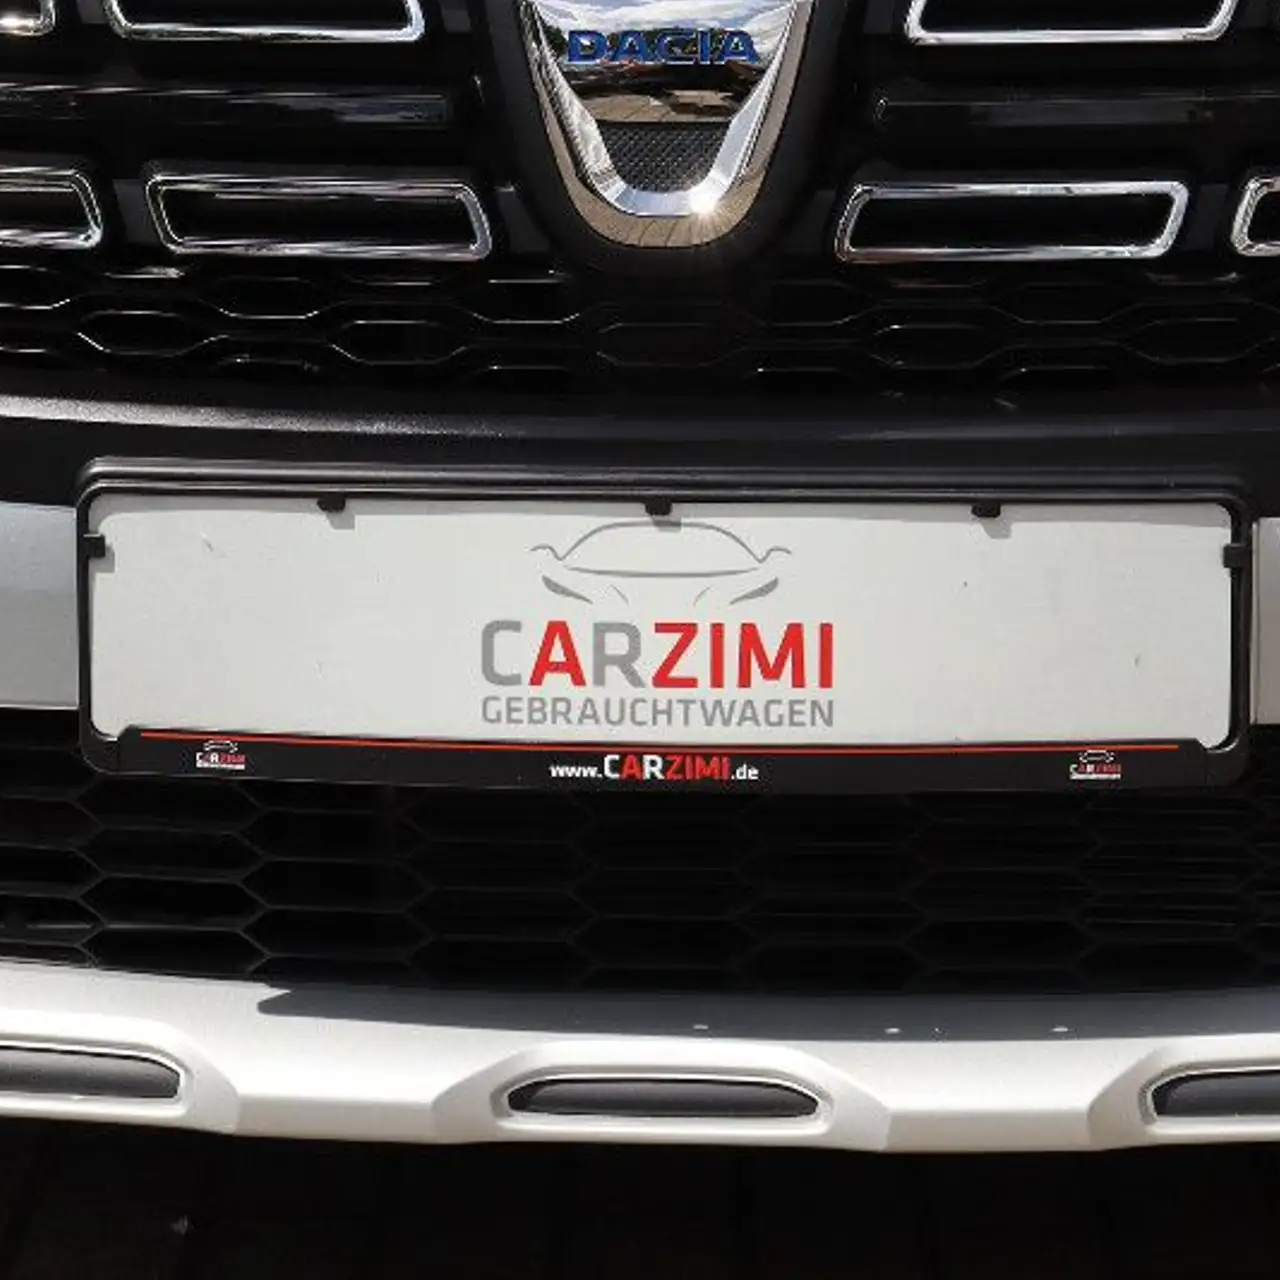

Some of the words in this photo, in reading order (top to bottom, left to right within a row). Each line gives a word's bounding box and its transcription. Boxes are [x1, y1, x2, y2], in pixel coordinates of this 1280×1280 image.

[568, 30, 761, 65] DACIA
[481, 620, 834, 689] CARZIMI
[482, 695, 834, 727] GEBRAUCHTWAGEN
[549, 754, 760, 781] www.CARZIMI.de
